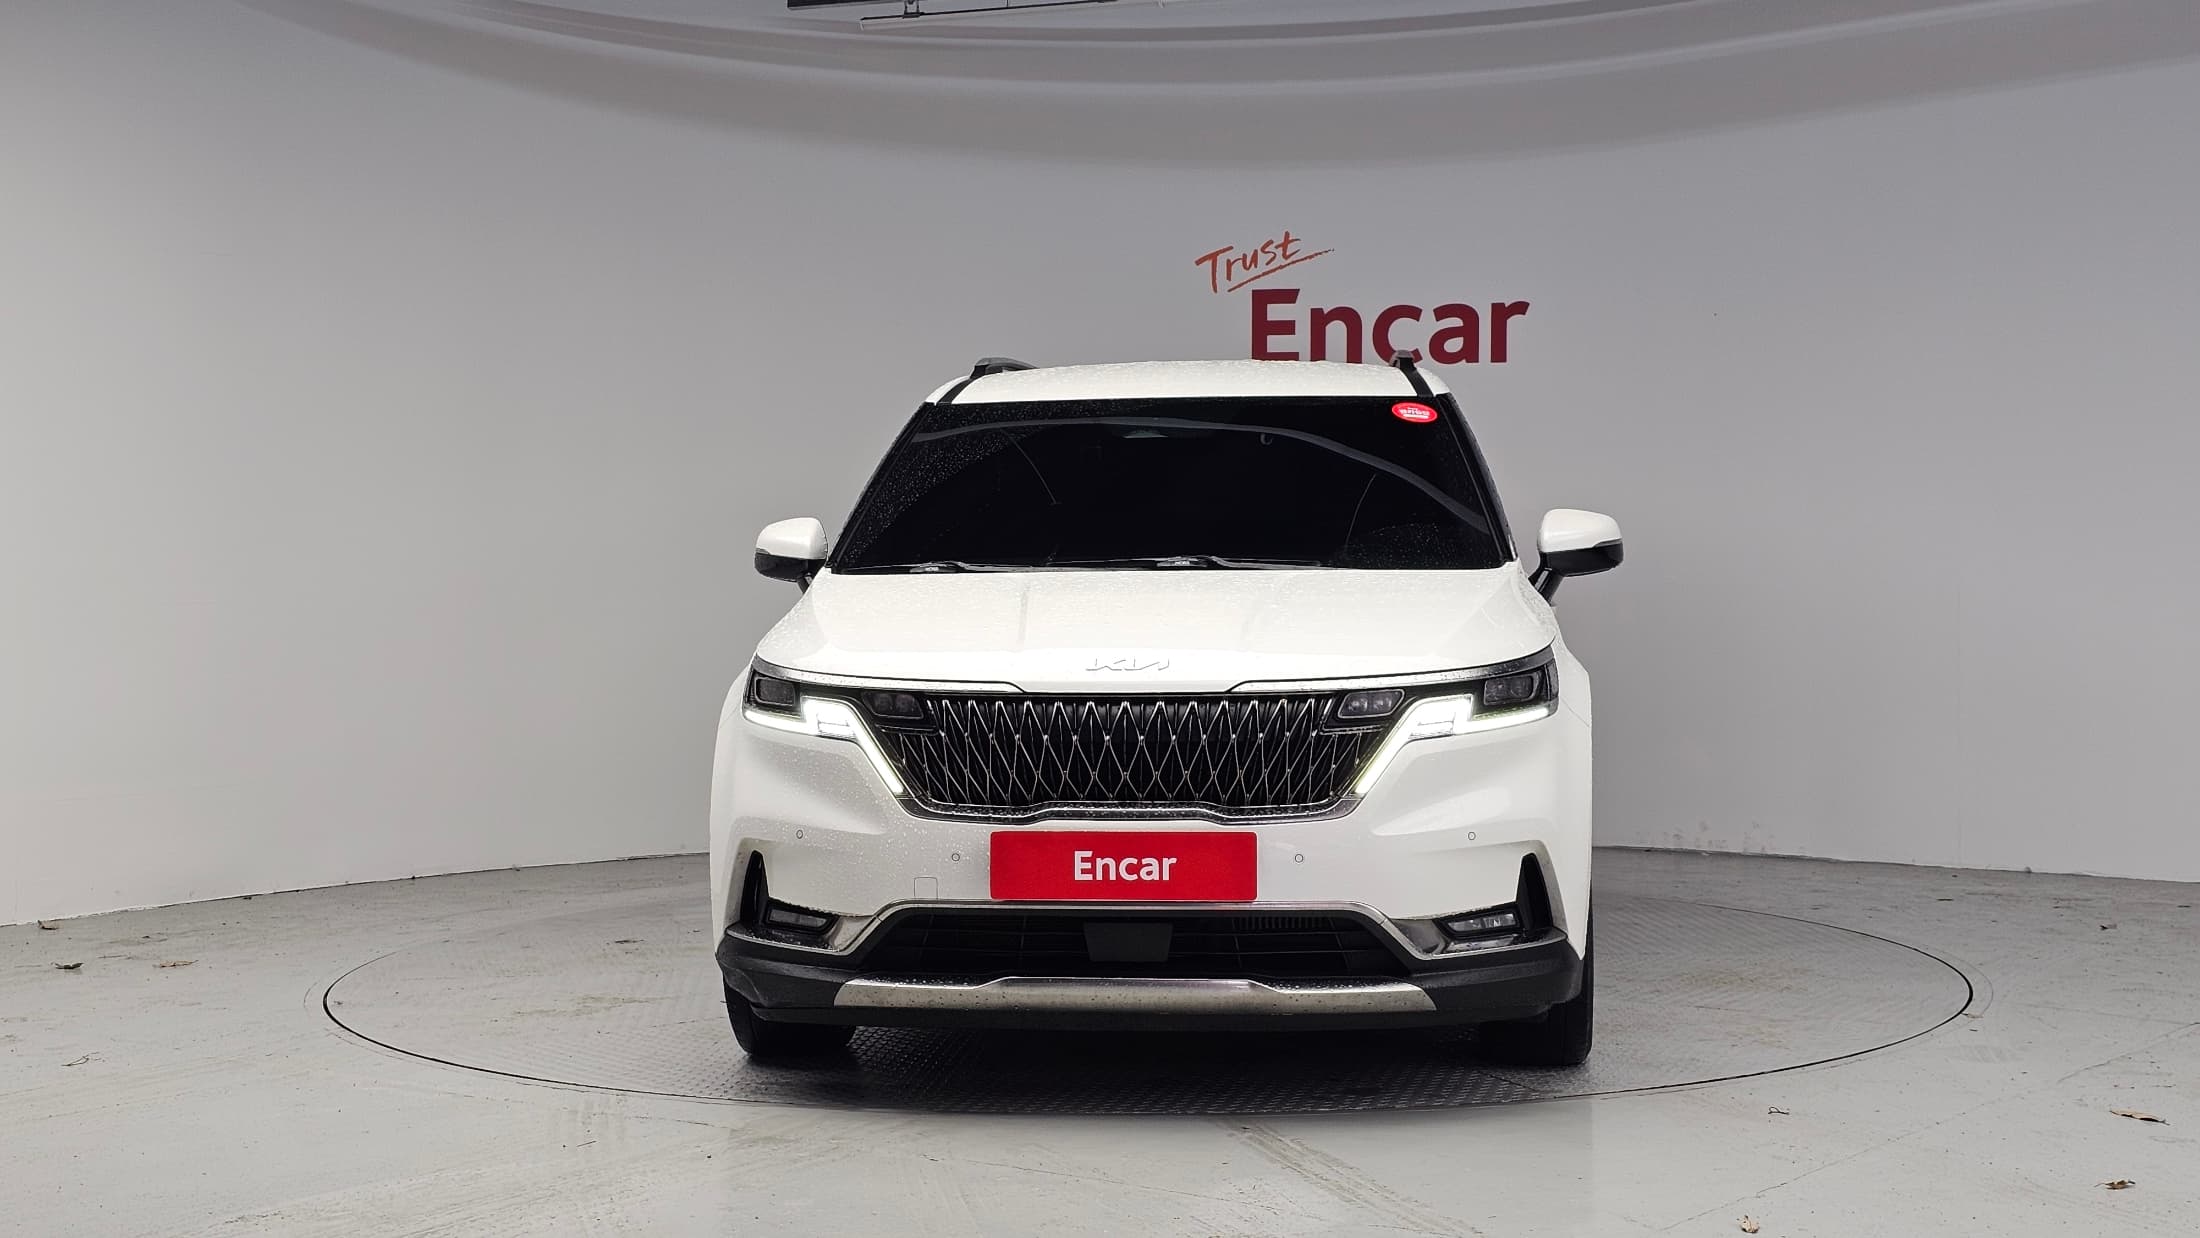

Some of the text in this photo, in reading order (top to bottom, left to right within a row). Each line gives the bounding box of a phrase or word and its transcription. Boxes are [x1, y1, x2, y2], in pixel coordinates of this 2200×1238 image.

[1195, 231, 1303, 293] Trust
[1251, 288, 1530, 365] Encar
[1073, 850, 1177, 881] Encar
